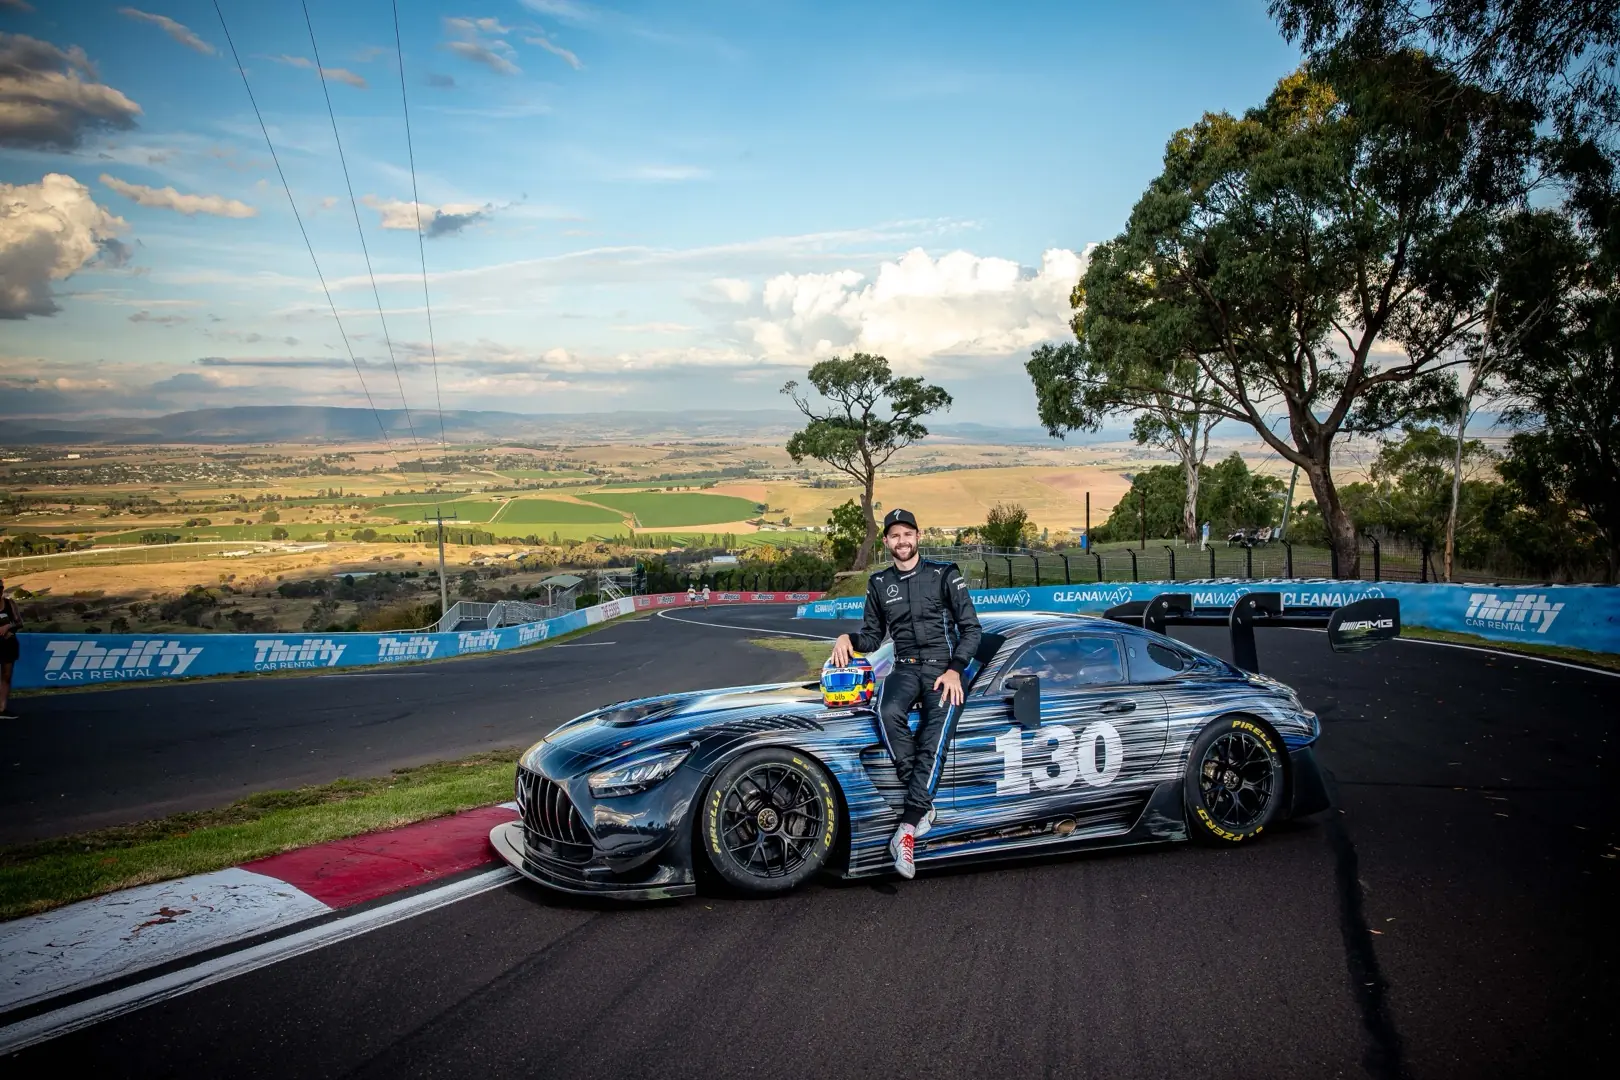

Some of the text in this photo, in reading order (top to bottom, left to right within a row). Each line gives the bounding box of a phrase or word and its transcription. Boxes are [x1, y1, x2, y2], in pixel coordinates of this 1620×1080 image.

[970, 593, 1026, 605] LEANAWAY
[1053, 591, 1128, 602] CLEANAWAY
[836, 602, 865, 610] CLEANA
[1465, 593, 1565, 634] Thrifty
[1355, 619, 1393, 630] AMG
[1466, 618, 1526, 632] CAR RENTAL
[378, 636, 439, 659] Thrifty
[458, 631, 502, 650] Thrifty
[44, 640, 204, 675] Thrifty
[254, 639, 347, 666] Thrifty
[379, 655, 393, 663] CAR
[254, 661, 318, 671] CAR RENTAL
[44, 669, 155, 681] CAR RENTAL
[1232, 720, 1277, 753] PIRELLI
[995, 720, 1123, 797] 130
[709, 790, 722, 854] PIRELLI
